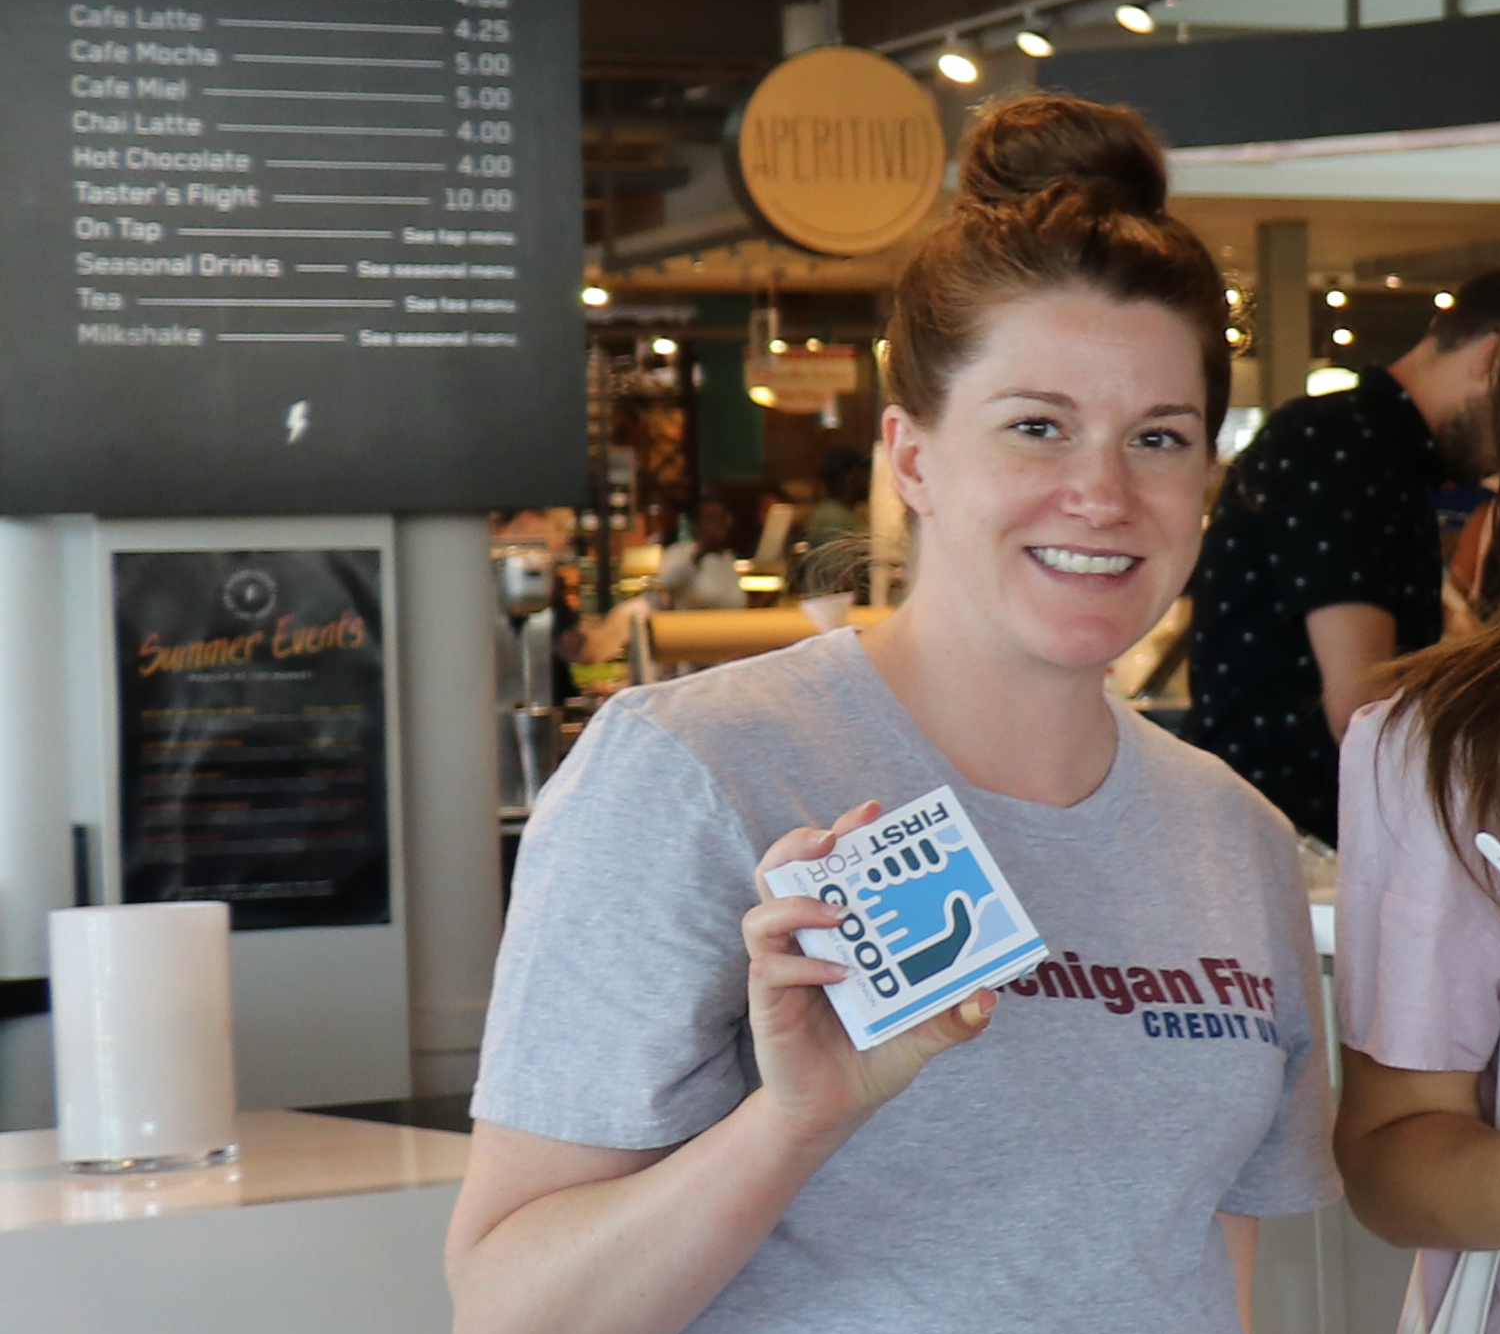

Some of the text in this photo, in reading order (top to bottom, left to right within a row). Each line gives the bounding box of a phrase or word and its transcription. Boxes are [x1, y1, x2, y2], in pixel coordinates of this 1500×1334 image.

[69, 3, 511, 42] Cafe Latte 4.25
[70, 39, 511, 77] Cafe Mocha 5.00
[71, 73, 512, 110] Cafe Miel 5.00
[72, 110, 513, 144] Chai Latte 4.00
[72, 145, 514, 178] Hot Chocolate 4.00
[74, 180, 514, 212] Taster's Flight 10.00
[74, 216, 112, 240] On
[117, 217, 164, 244] Tap
[75, 251, 194, 276] Seasonal
[199, 252, 283, 278] Drinks
[76, 287, 124, 312] Tea
[77, 323, 204, 347] Milkshake
[139, 611, 367, 677] Summer Events
[869, 801, 949, 856] FIRST
[806, 845, 864, 884] FOR
[819, 883, 900, 999] GOOD
[997, 951, 1204, 1014] chigan
[1141, 1009, 1250, 1039] CREDIT
